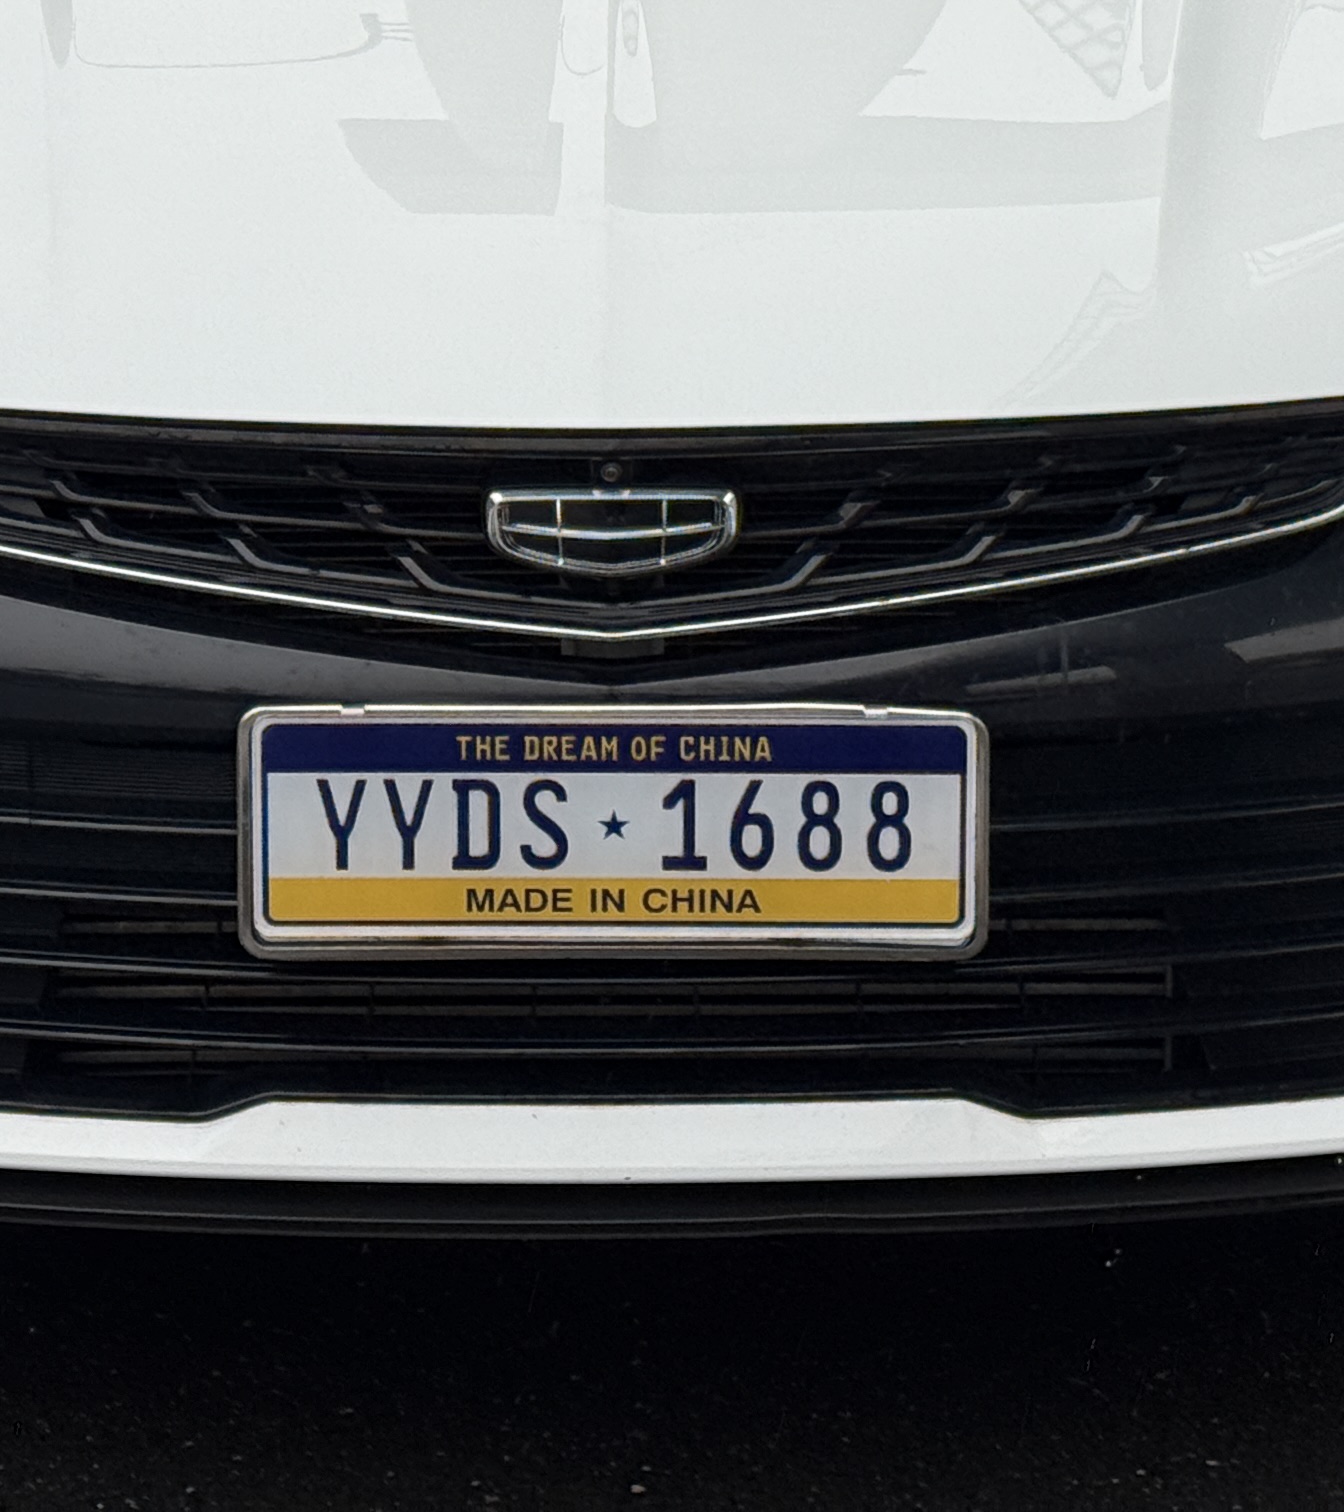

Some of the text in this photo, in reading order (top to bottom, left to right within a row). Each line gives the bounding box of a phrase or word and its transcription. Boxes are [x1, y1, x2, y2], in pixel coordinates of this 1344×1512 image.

[457, 735, 773, 762] THE DREAM OF CHINA
[316, 779, 913, 872] YYDS 1688
[466, 888, 762, 914] MADE IN CHINA
